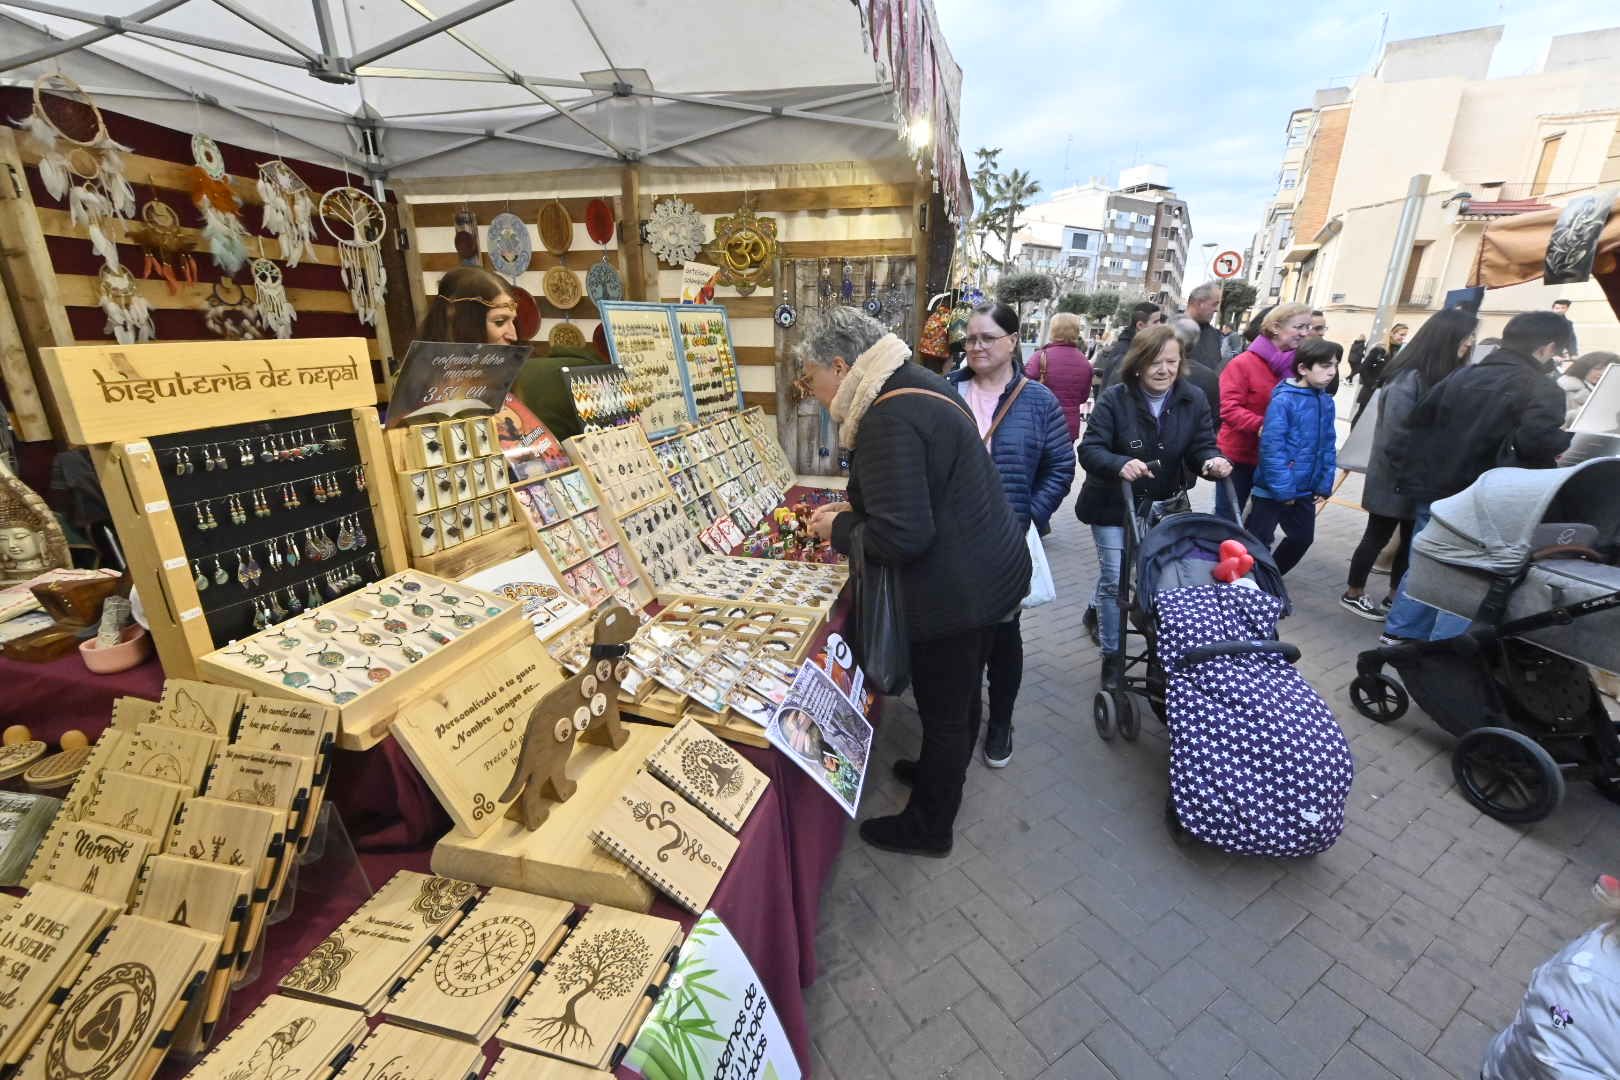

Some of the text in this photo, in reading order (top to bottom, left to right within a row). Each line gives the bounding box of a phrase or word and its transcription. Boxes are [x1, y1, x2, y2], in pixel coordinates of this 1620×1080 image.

[256, 358, 292, 388] de
[297, 354, 359, 390] nepal
[505, 679, 515, 688] tu
[516, 663, 537, 683] gusto
[74, 829, 134, 864] Namaste
[714, 983, 757, 1080] demos de
[738, 1047, 747, 1068] y
[746, 996, 767, 1052] hojas
